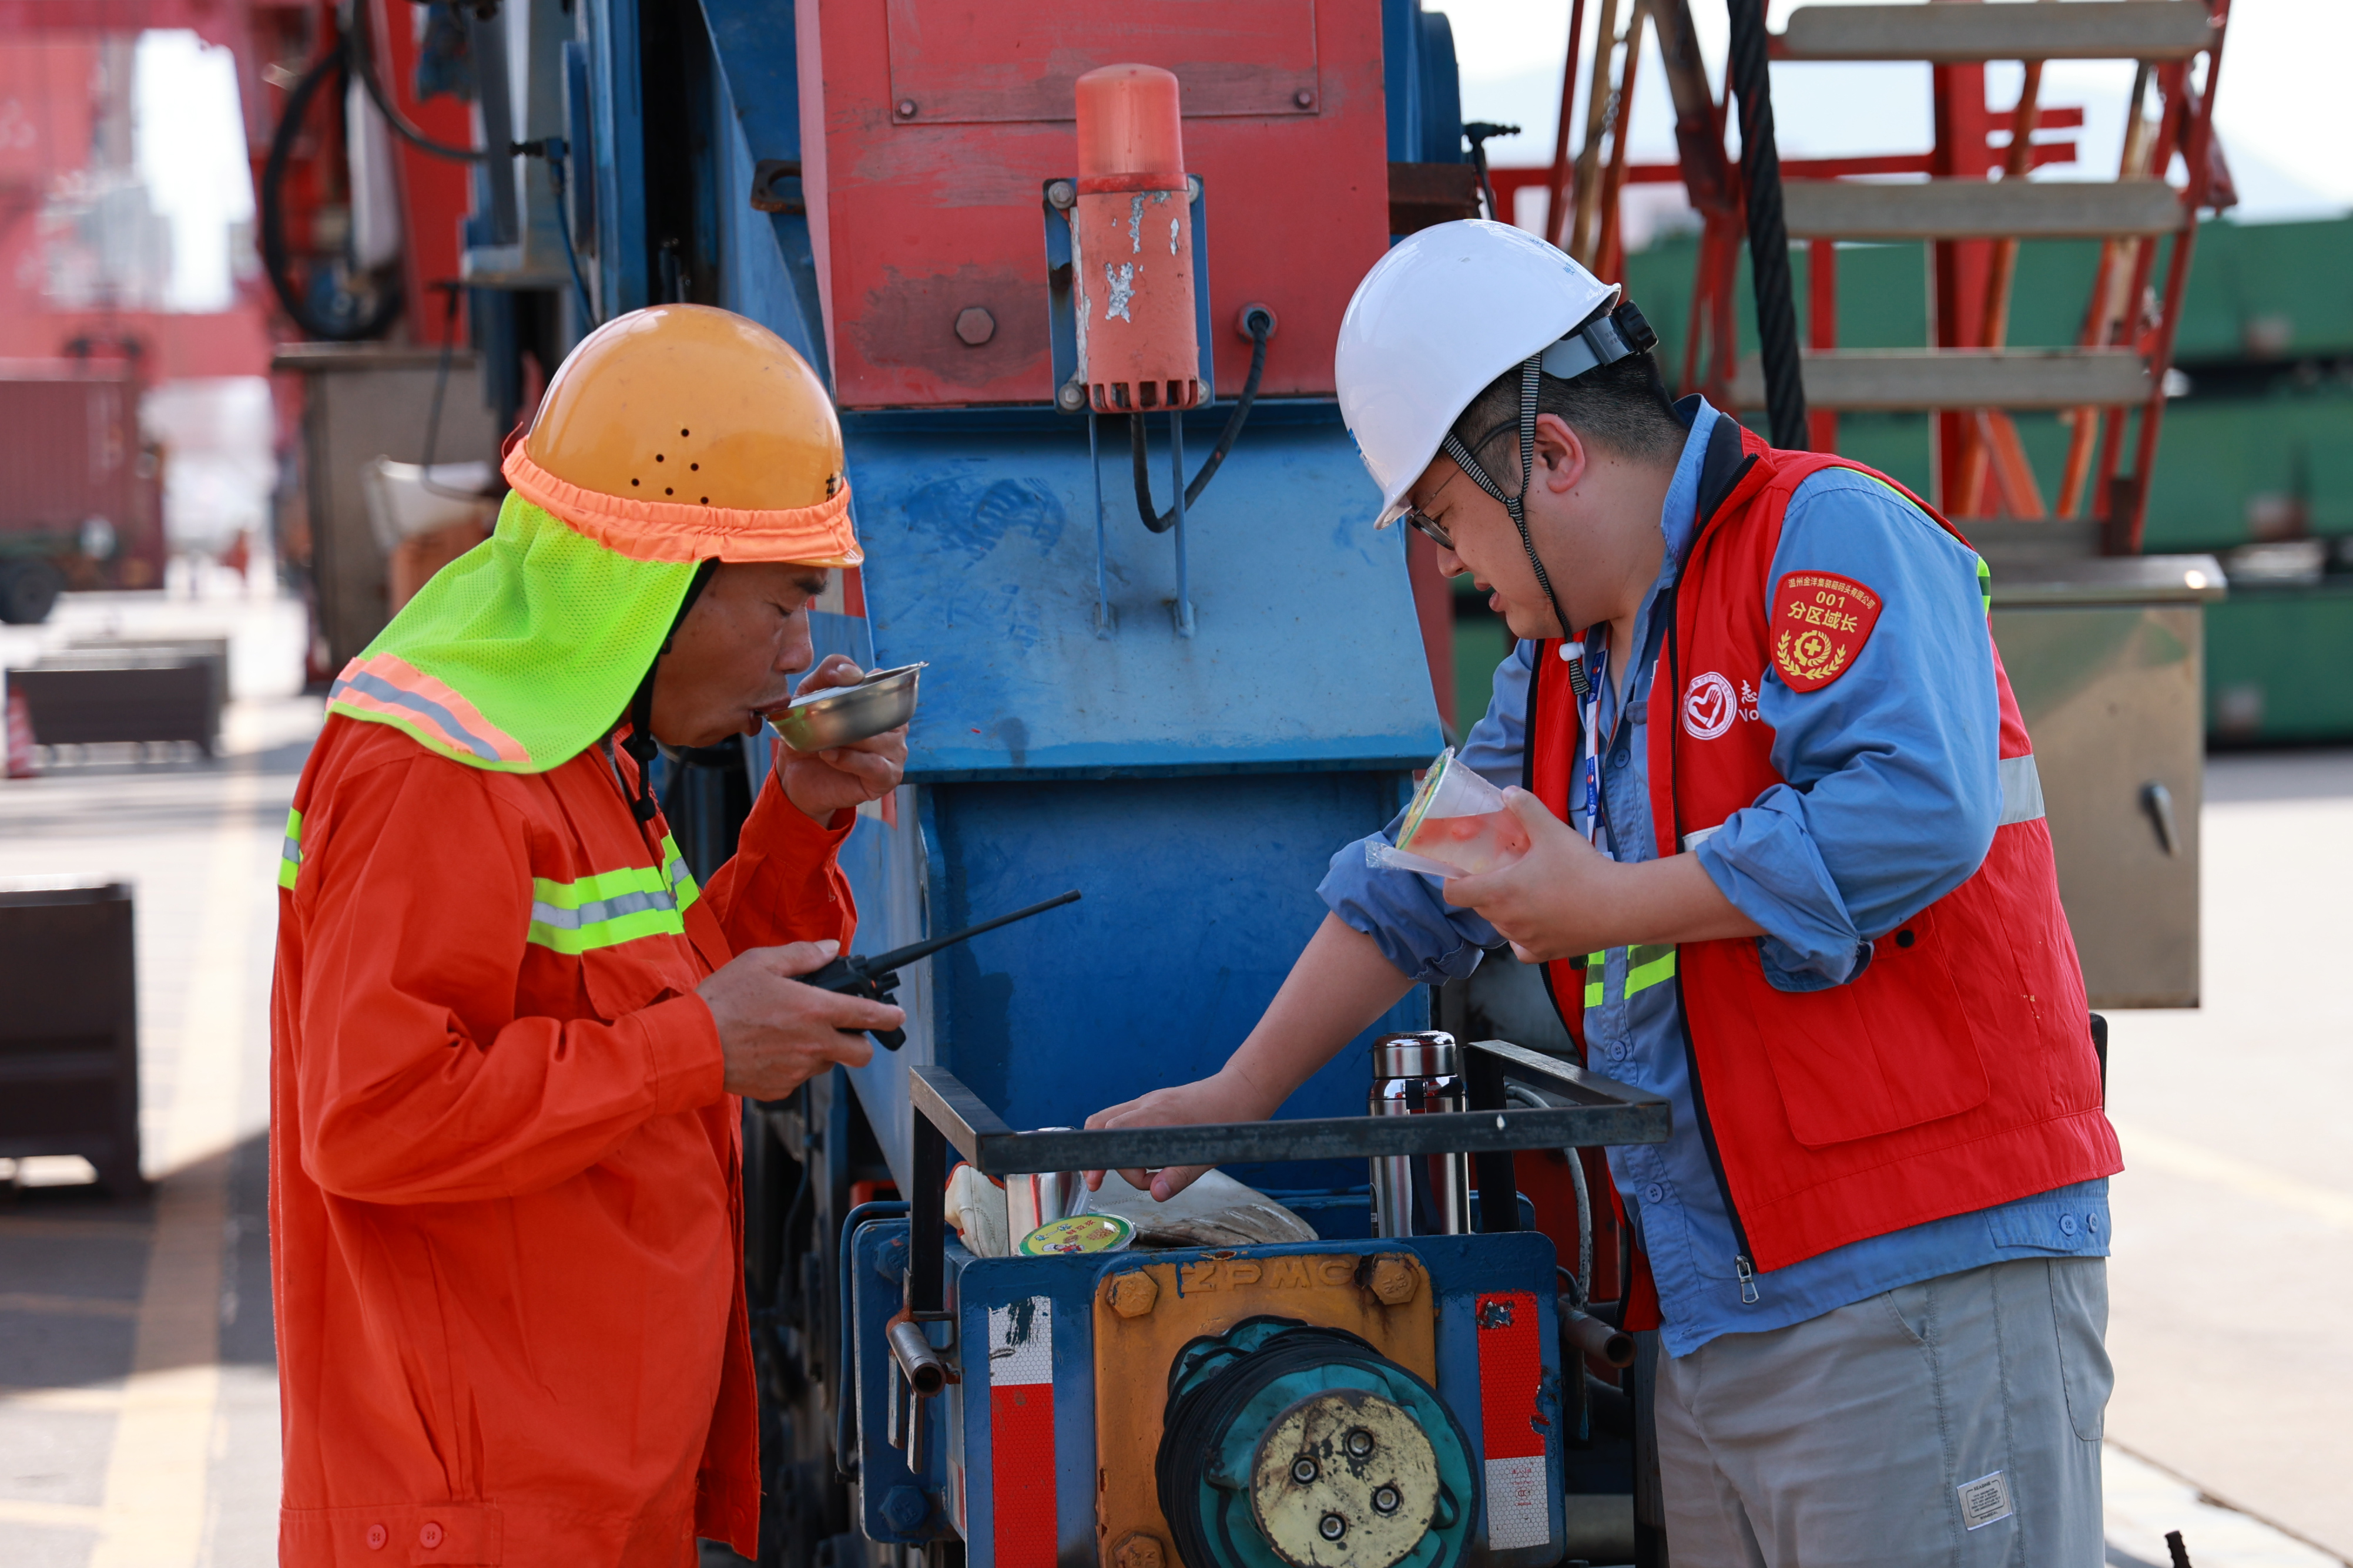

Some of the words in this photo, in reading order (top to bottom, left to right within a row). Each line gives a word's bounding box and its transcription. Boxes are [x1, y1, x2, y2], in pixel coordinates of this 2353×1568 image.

[1788, 577, 1876, 609] 温州金洋集装箱码头有限公司
[1816, 591, 1846, 608] 001
[1787, 600, 1858, 633] 分区域长
[1180, 1258, 1352, 1293] ZPMC
